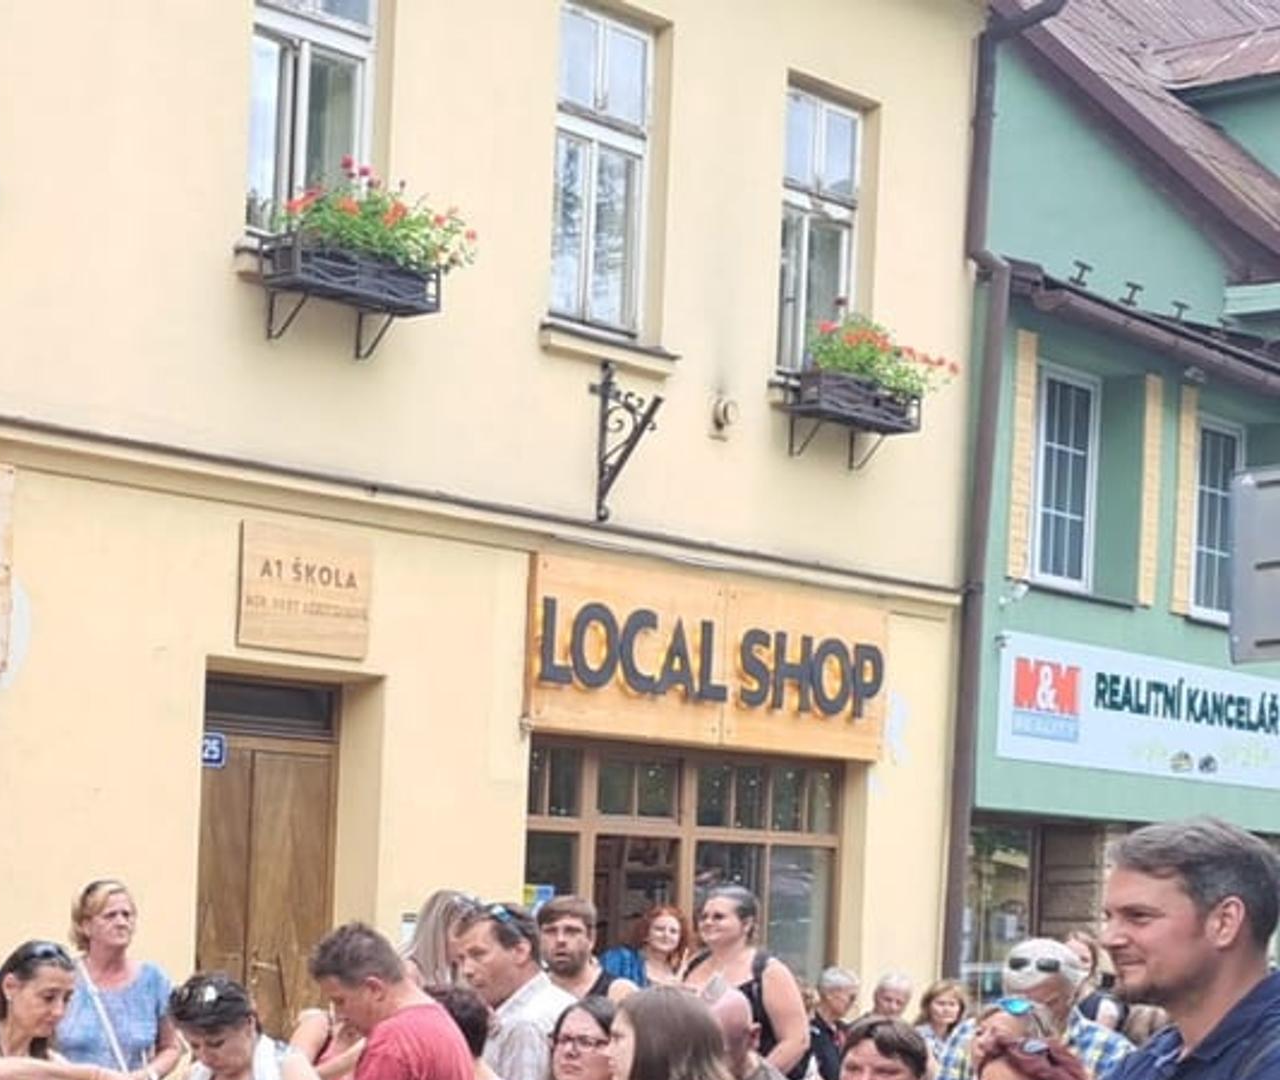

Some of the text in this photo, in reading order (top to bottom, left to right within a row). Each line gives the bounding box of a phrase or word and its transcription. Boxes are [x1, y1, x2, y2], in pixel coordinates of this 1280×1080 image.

[260, 556, 358, 590] A1 ŠKOLA
[540, 596, 884, 718] LOCAL SHOP
[1014, 656, 1082, 716] M&M
[1093, 671, 1279, 735] REALITNÍ KANCELÁŘ
